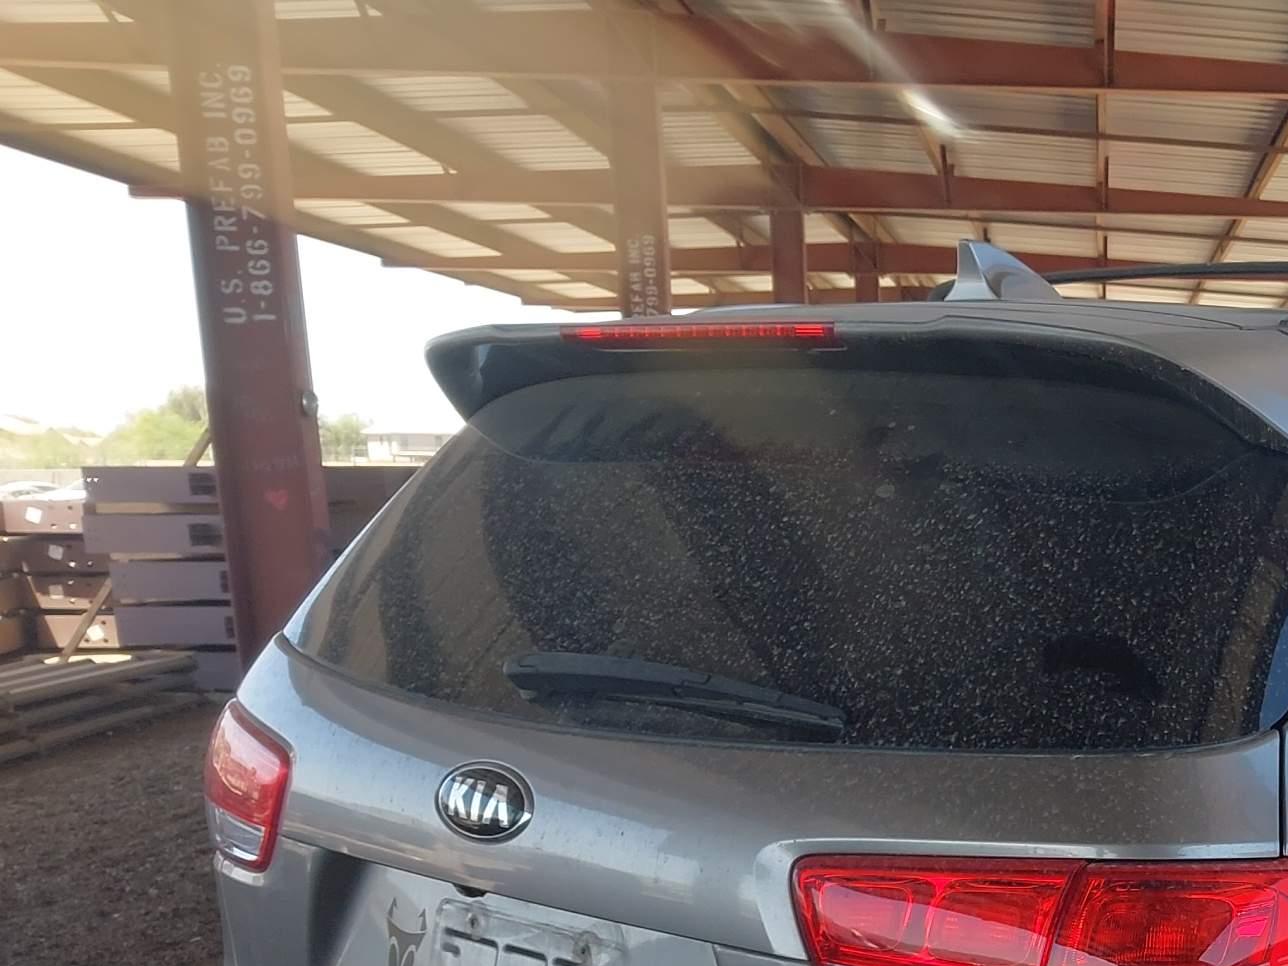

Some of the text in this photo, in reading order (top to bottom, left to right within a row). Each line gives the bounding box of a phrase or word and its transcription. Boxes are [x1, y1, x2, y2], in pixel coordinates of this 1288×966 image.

[200, 63, 248, 324] U.S. PREFAB INC.
[227, 64, 277, 322] 1-866-799-0969
[642, 234, 658, 317] 799-0969
[447, 776, 509, 829] KIA
